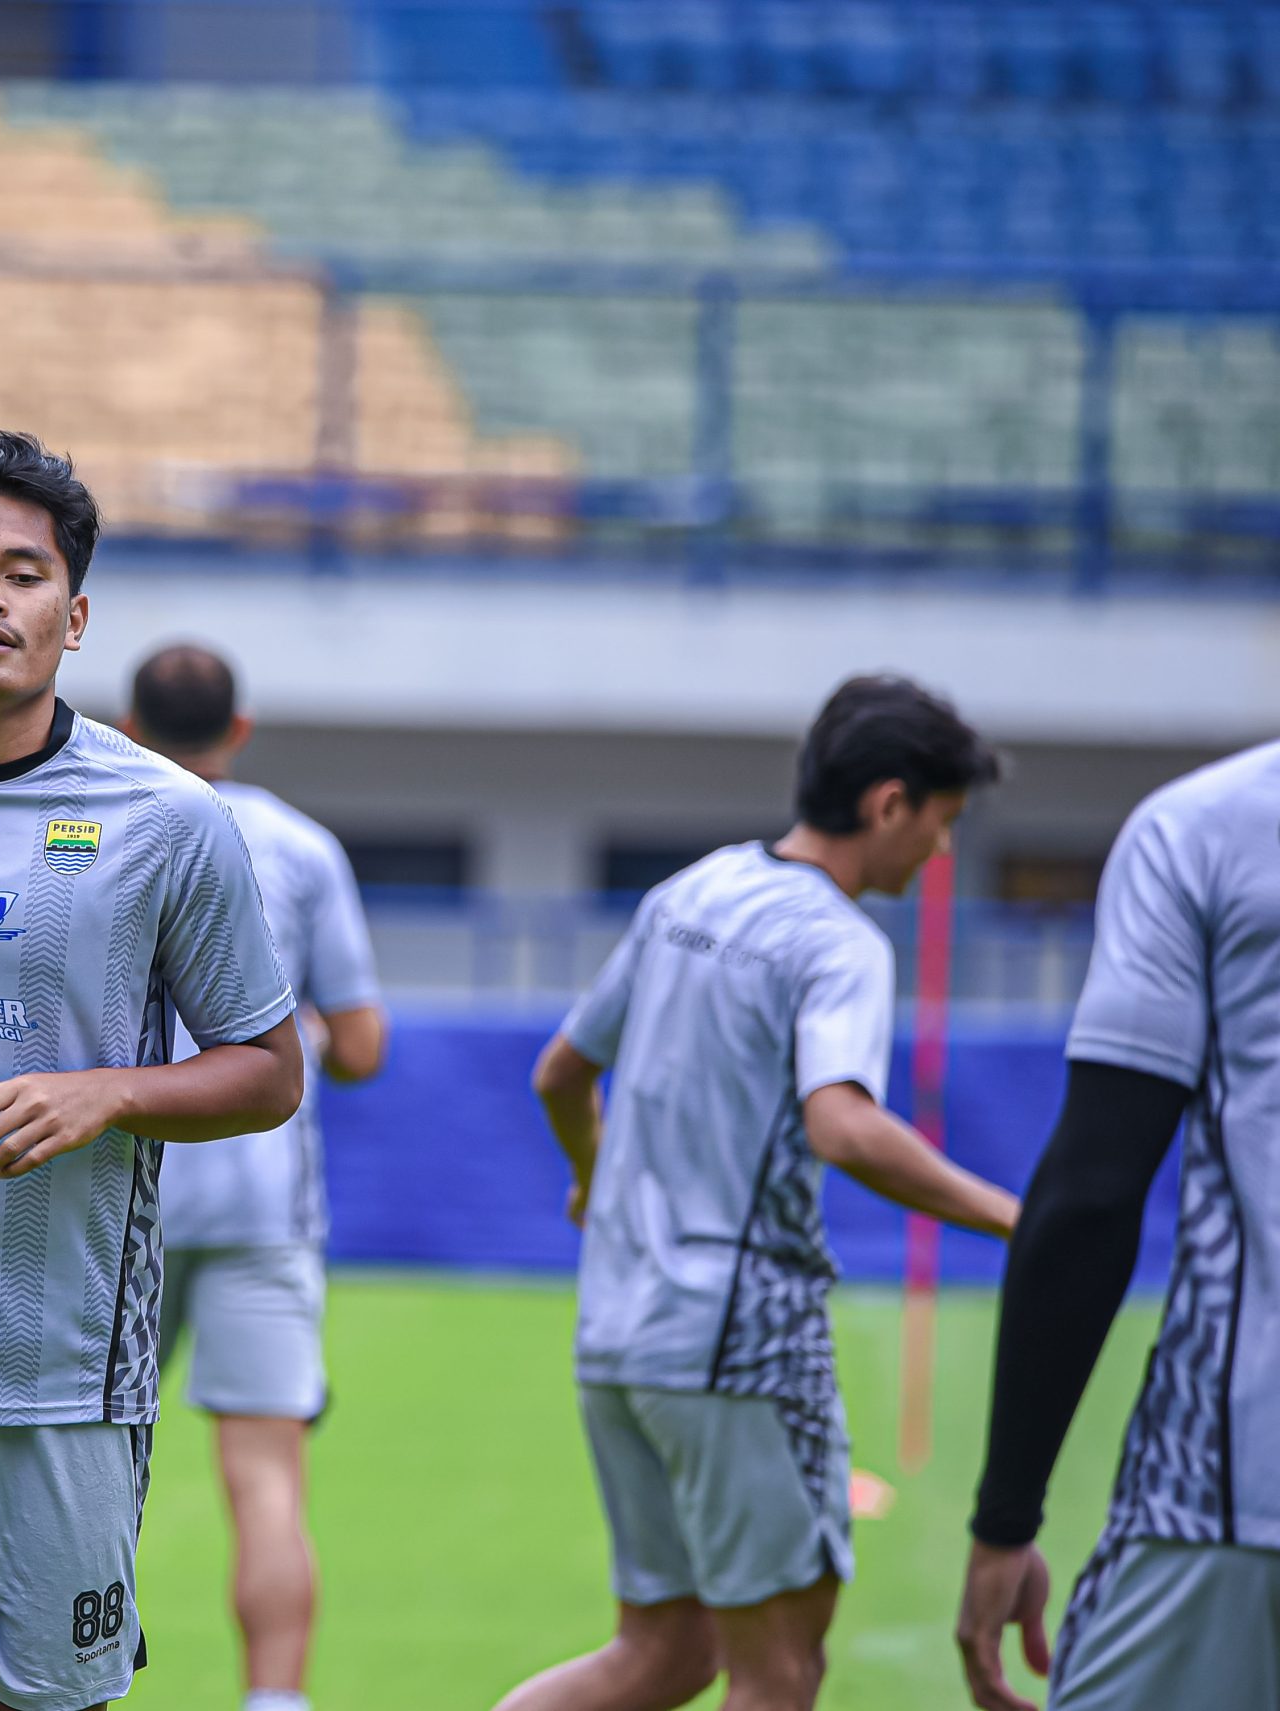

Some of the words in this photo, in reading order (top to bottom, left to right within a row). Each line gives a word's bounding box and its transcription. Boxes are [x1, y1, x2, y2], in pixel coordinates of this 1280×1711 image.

[53, 823, 96, 834] PERSIB
[72, 1580, 125, 1649] 88
[75, 1640, 121, 1665] Sportama
